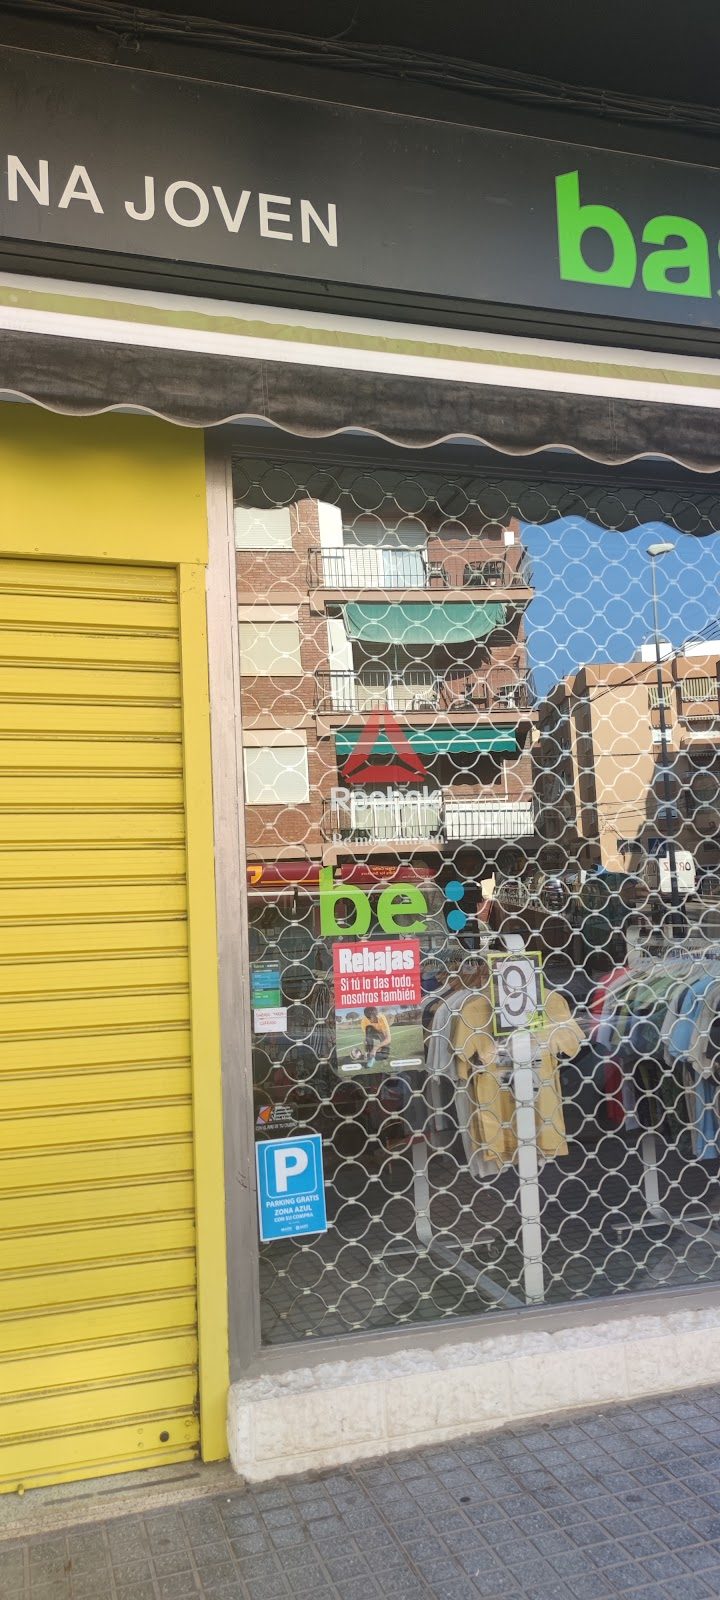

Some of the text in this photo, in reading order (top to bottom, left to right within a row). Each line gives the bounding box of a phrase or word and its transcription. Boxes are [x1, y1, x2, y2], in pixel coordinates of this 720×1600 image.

[7, 154, 338, 248] NA JOVEN
[555, 169, 720, 299] ba
[339, 946, 414, 975] Rebajas
[341, 974, 414, 992] Si tú lo das todo,
[341, 988, 415, 1005] nosotros también
[274, 1147, 308, 1193] P
[266, 1194, 320, 1208] PARKING GRATIS
[274, 1205, 312, 1216] ZONA AZUL
[293, 1212, 313, 1220] COMPRA
